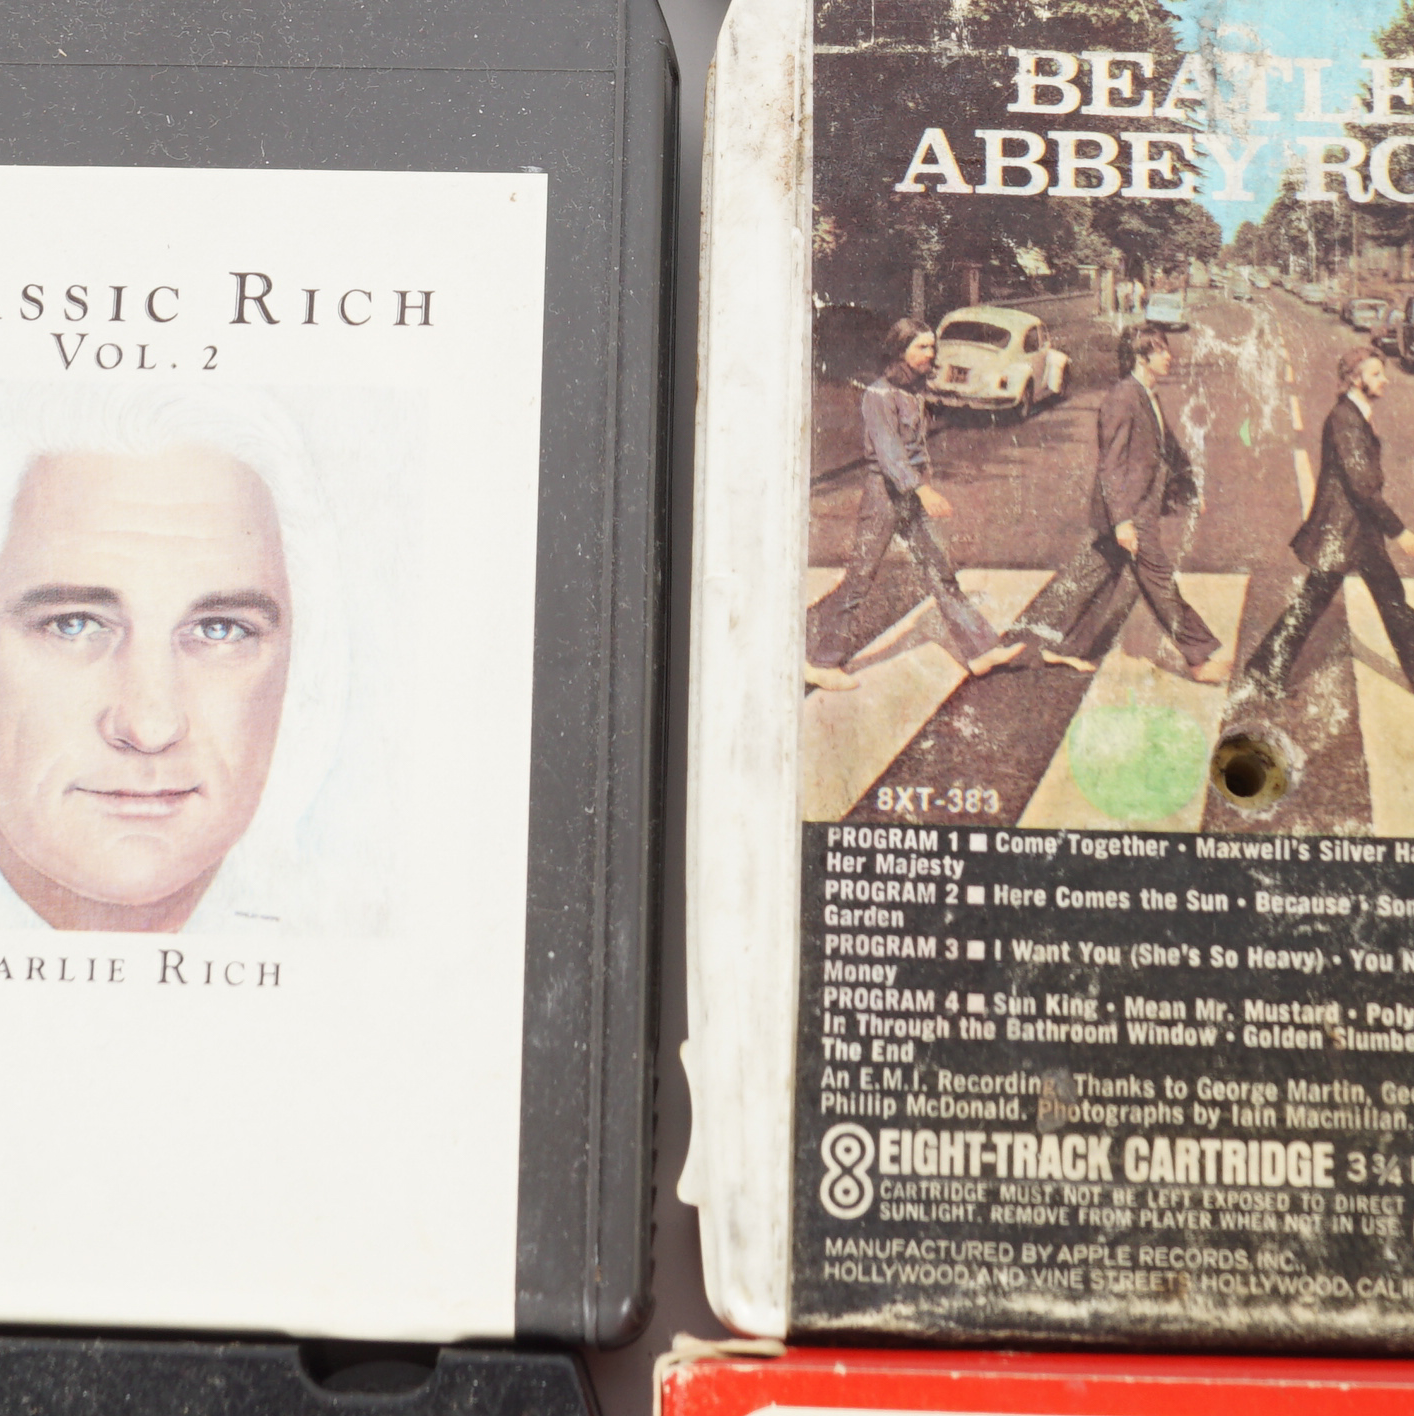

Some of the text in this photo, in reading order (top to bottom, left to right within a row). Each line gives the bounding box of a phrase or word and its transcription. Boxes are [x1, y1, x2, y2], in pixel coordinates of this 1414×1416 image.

[894, 128, 1282, 202] ABBEY
[229, 272, 434, 325] RICH
[50, 333, 217, 370] VOL. 2
[877, 786, 1001, 814] 8XT-383
[828, 827, 937, 850] PROGRAM
[949, 832, 957, 851] 1
[996, 832, 1061, 859] Come
[1067, 833, 1168, 859] Together
[1195, 837, 1310, 861] Maxwell's
[1320, 840, 1385, 861] Silver
[827, 852, 963, 879] Her Majesty
[158, 949, 279, 986] RICH
[879, 1128, 1112, 1182] EIGHT-TRACK
[1124, 1135, 1335, 1188] CARTRIDGE
[825, 1238, 1014, 1262] MANUFACTURED
[1021, 1243, 1051, 1264] BY
[1056, 1245, 1131, 1267] APPLE
